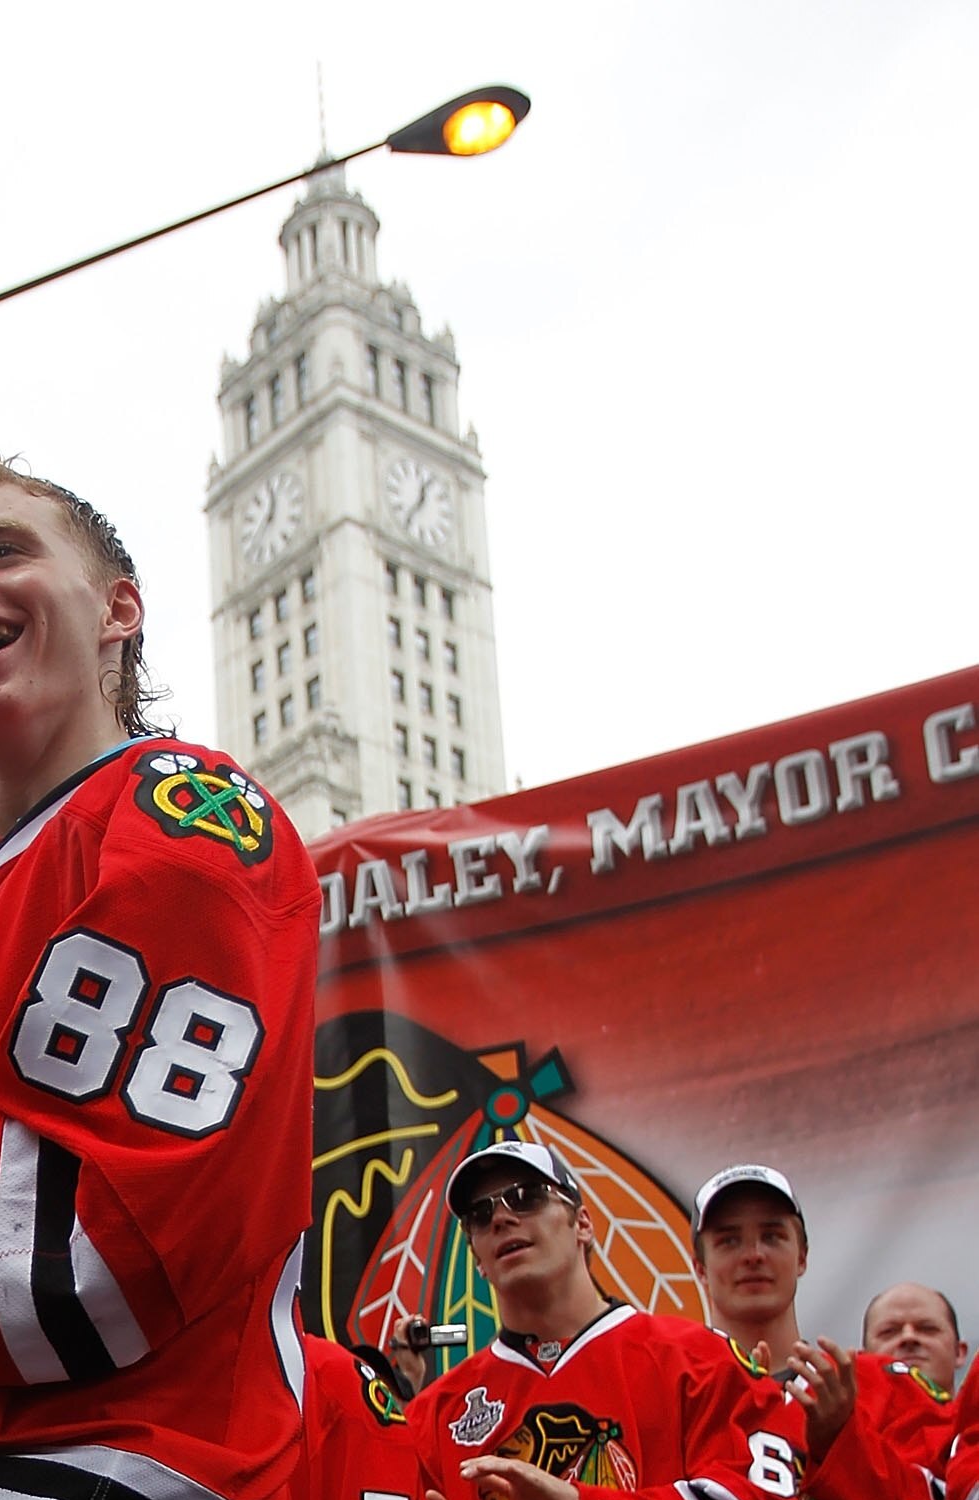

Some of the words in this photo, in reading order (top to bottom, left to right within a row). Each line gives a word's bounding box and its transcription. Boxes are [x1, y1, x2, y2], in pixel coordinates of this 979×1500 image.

[587, 731, 900, 874] MAYOR
[7, 926, 265, 1139] 88
[747, 1430, 797, 1498] 6
